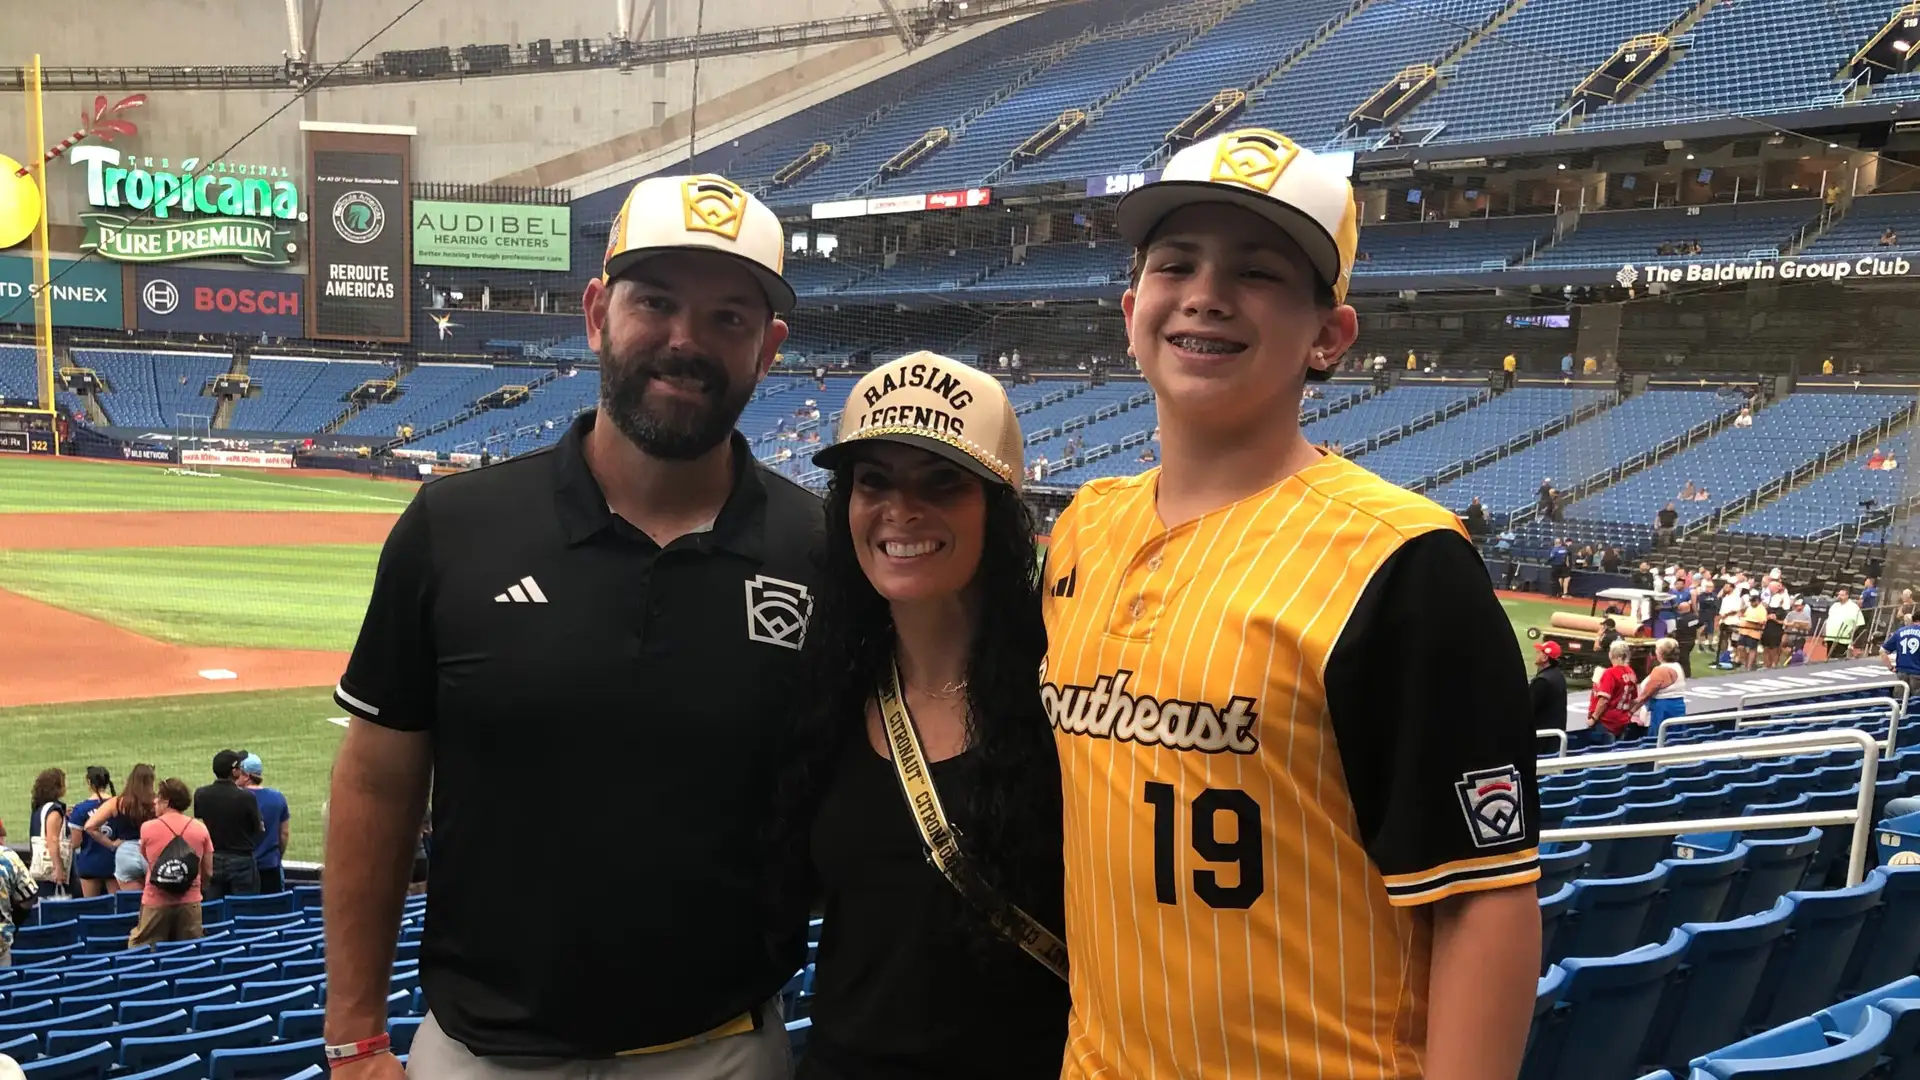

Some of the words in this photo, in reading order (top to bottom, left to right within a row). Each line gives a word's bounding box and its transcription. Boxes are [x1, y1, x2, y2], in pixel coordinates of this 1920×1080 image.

[128, 155, 169, 168] THE
[71, 145, 298, 219] Tropicana
[416, 214, 567, 236] AUDIBEL
[100, 226, 161, 254] PURE
[166, 226, 272, 253] PREMIUM
[434, 234, 488, 246] HEARING
[495, 236, 549, 248] CENTERS
[472, 252, 500, 260] through
[502, 254, 545, 262] professional
[330, 264, 388, 282] REROUTE
[1644, 266, 1682, 283] The
[1686, 261, 1775, 282] Baldwin
[1780, 259, 1851, 282] Group
[1855, 256, 1910, 276] Club
[28, 284, 108, 302] SNNEX
[325, 280, 394, 299] AMERICAS
[194, 286, 298, 316] BOSCH
[863, 364, 974, 411] RAISING
[860, 405, 964, 436] LEGENDS
[32, 440, 48, 451] 322
[143, 450, 169, 460] NETWORK
[1900, 638, 1920, 654] 19
[1144, 780, 1264, 910] 19
[1682, 848, 1689, 858] S
